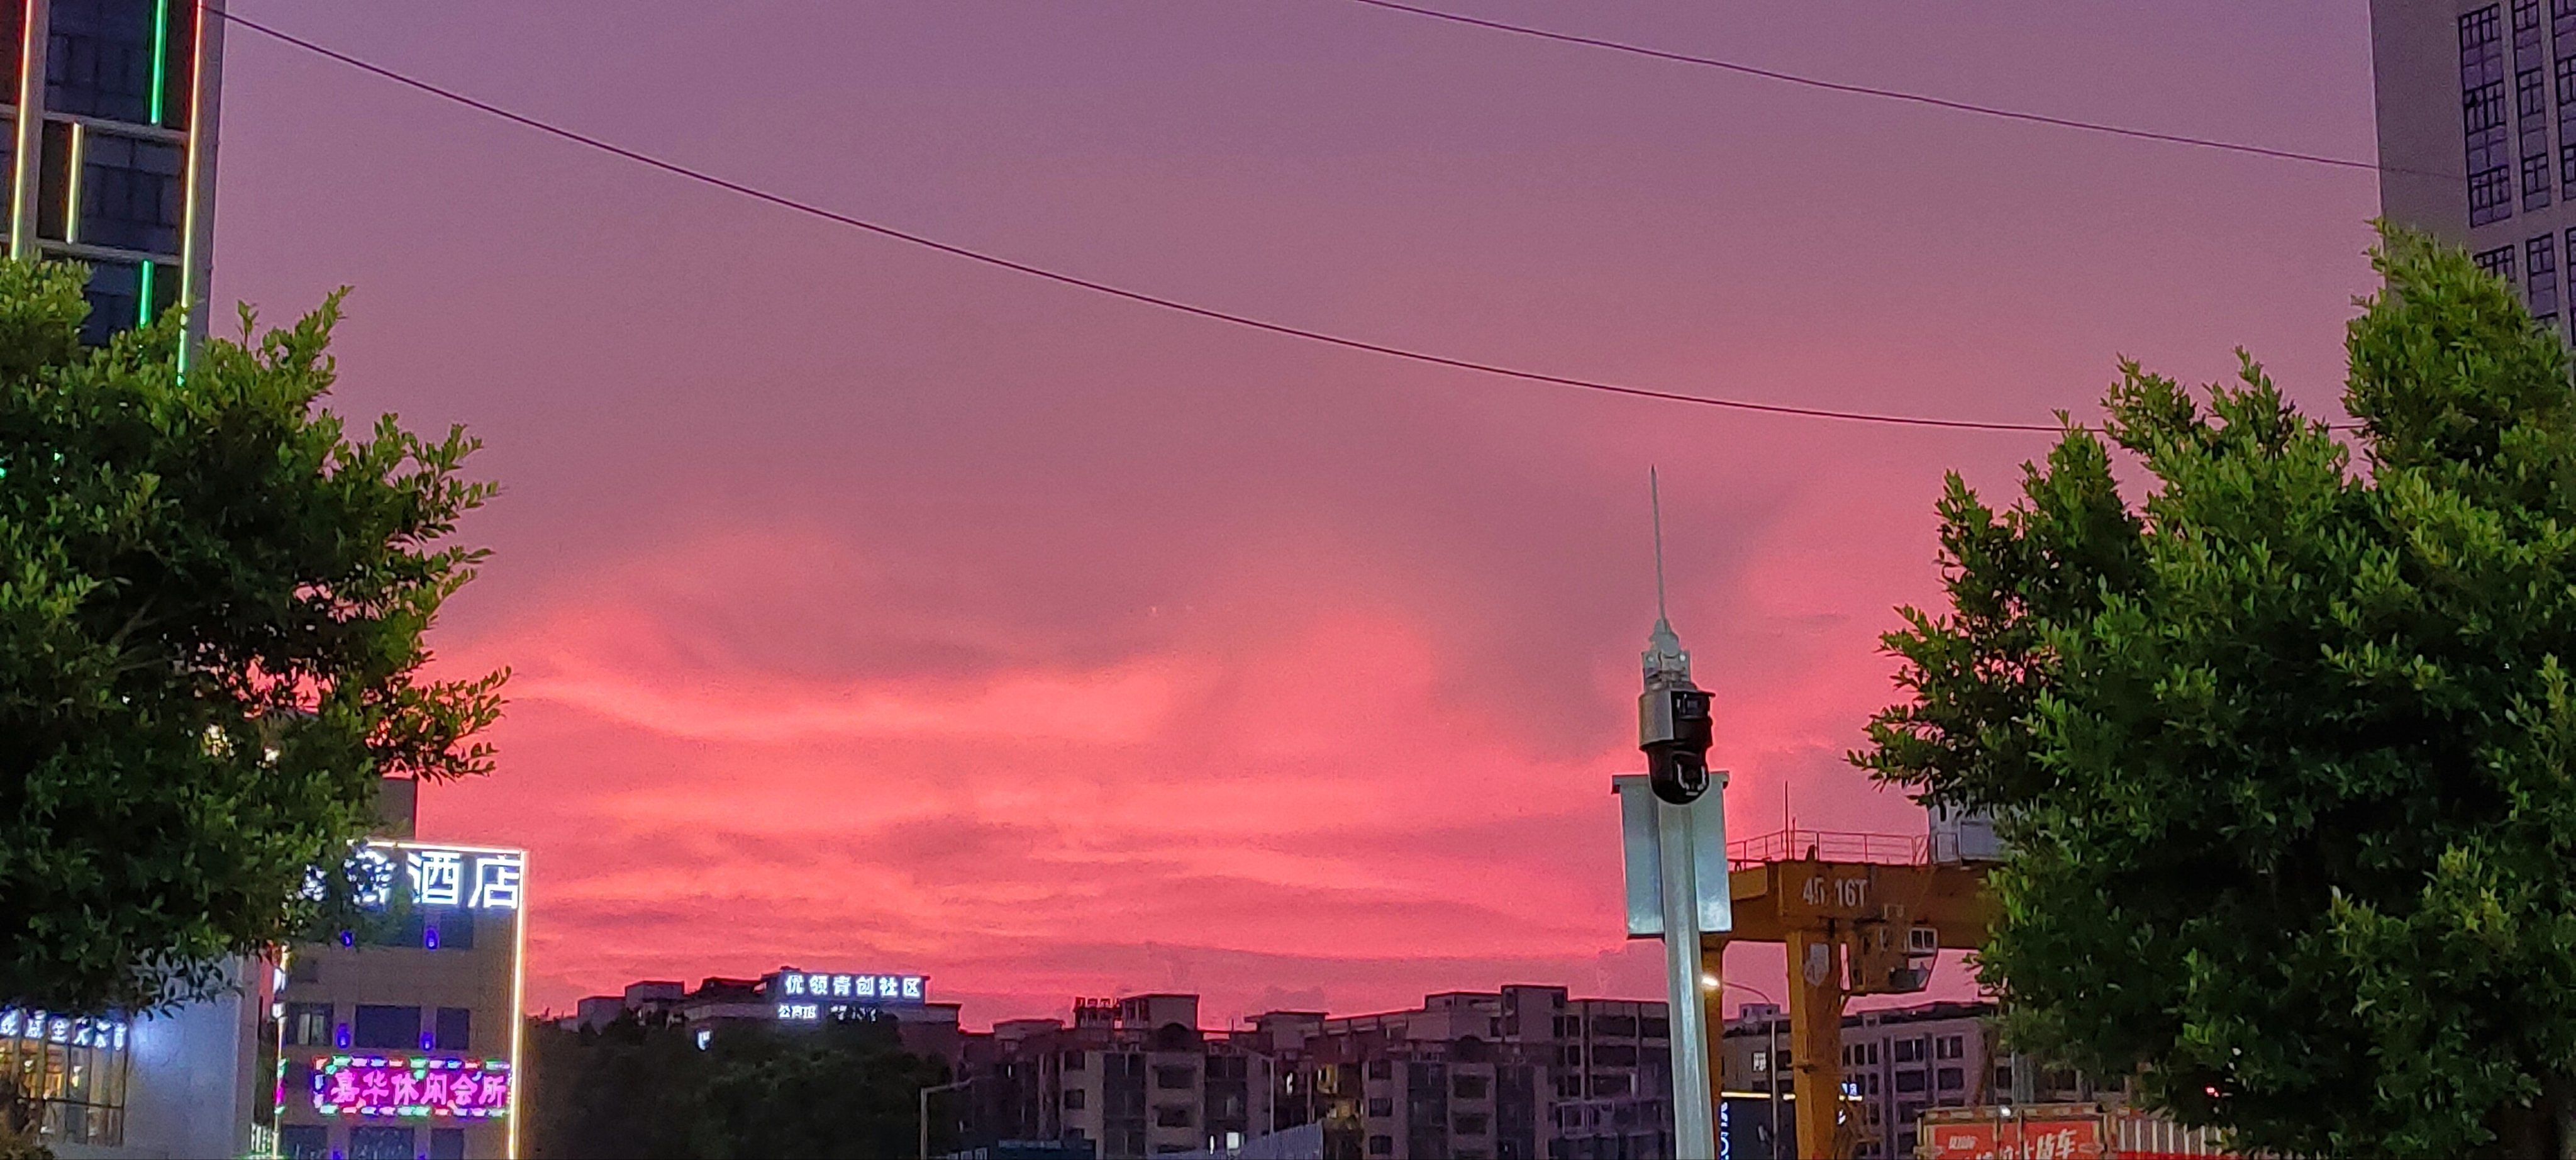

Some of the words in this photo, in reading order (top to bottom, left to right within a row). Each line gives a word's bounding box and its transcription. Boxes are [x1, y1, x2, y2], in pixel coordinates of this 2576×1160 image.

[1835, 878, 1867, 908] 16T
[786, 975, 921, 997] 优领青创社区
[331, 1070, 507, 1108] 嘉华休闲会所
